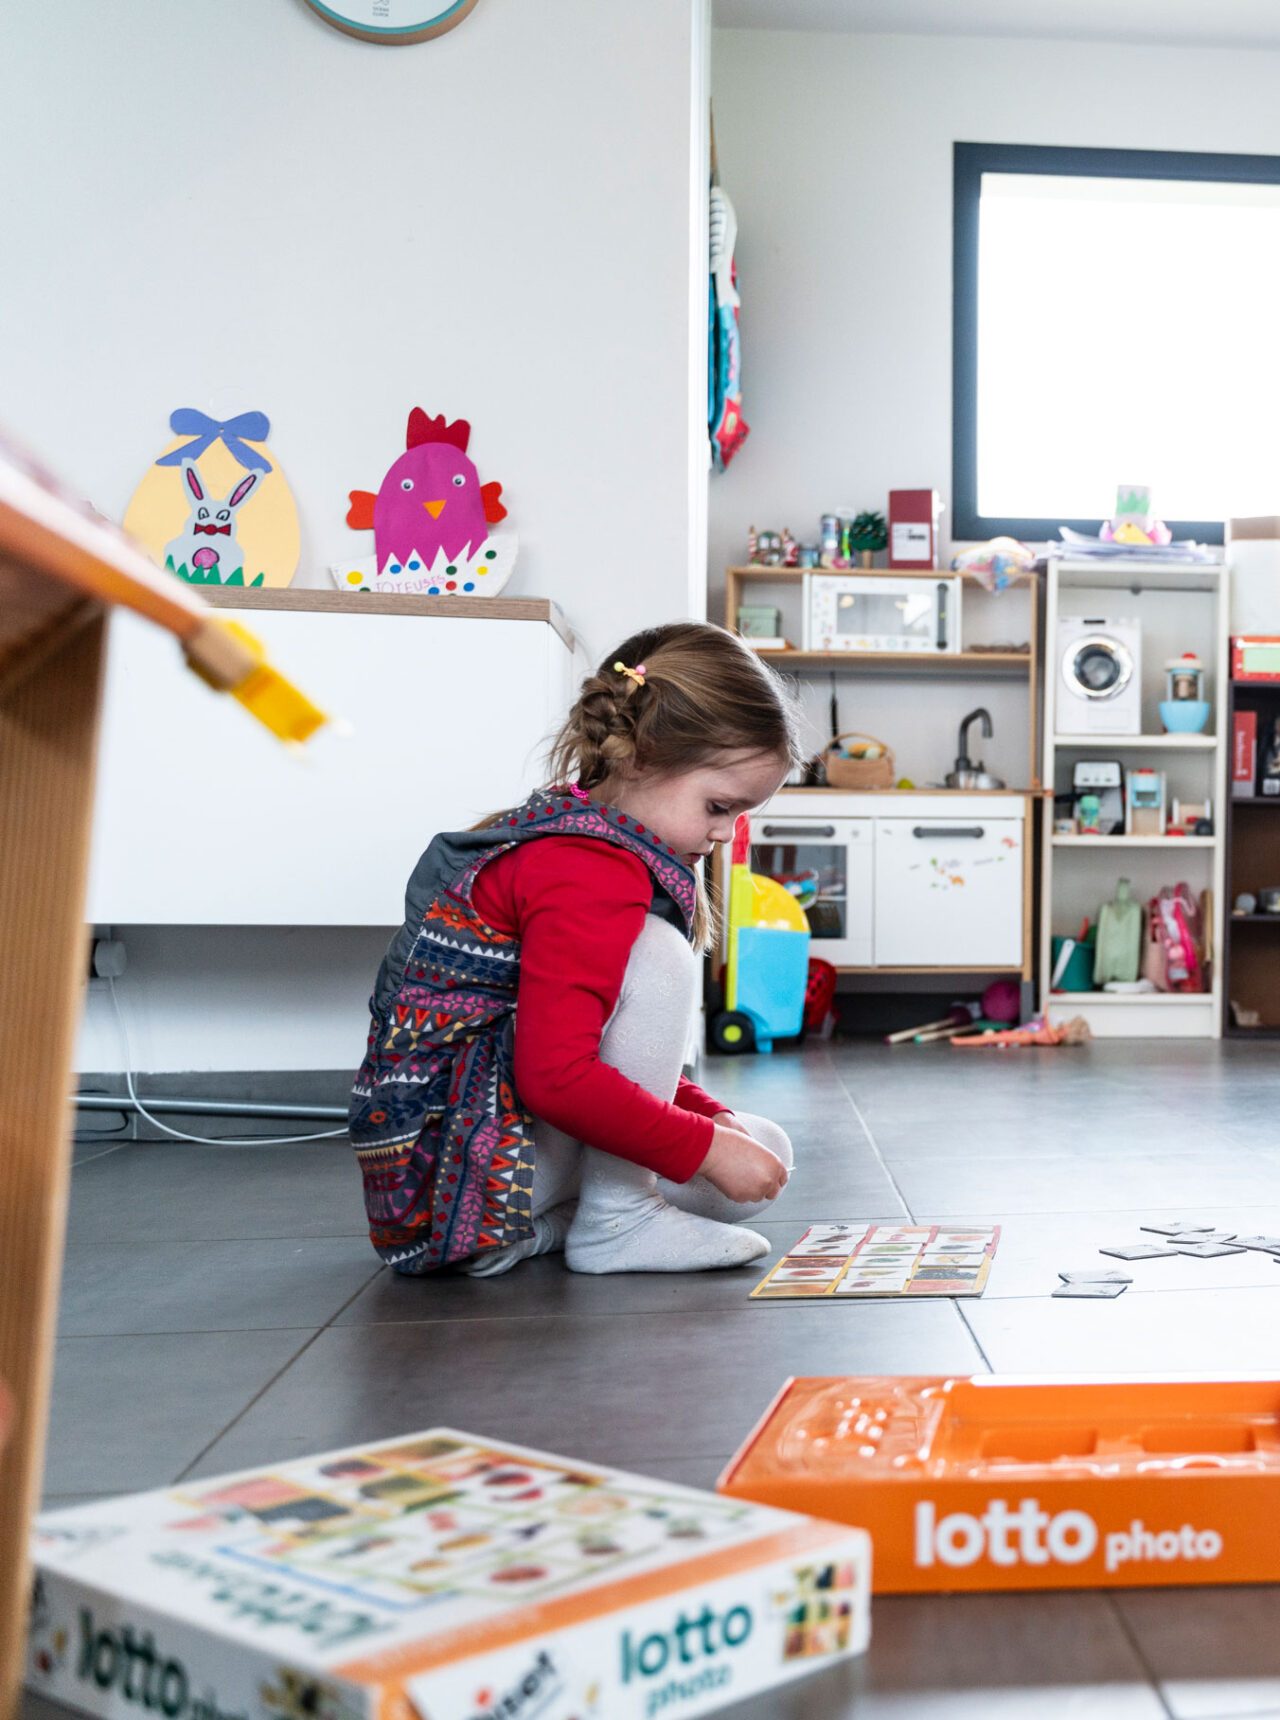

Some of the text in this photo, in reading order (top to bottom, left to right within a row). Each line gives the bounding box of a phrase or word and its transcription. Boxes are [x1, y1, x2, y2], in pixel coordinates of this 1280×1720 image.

[915, 1498, 1222, 1572] lotto photo
[77, 1606, 189, 1719] lotto
[621, 1603, 754, 1684] lotto
[645, 1664, 732, 1717] photo
